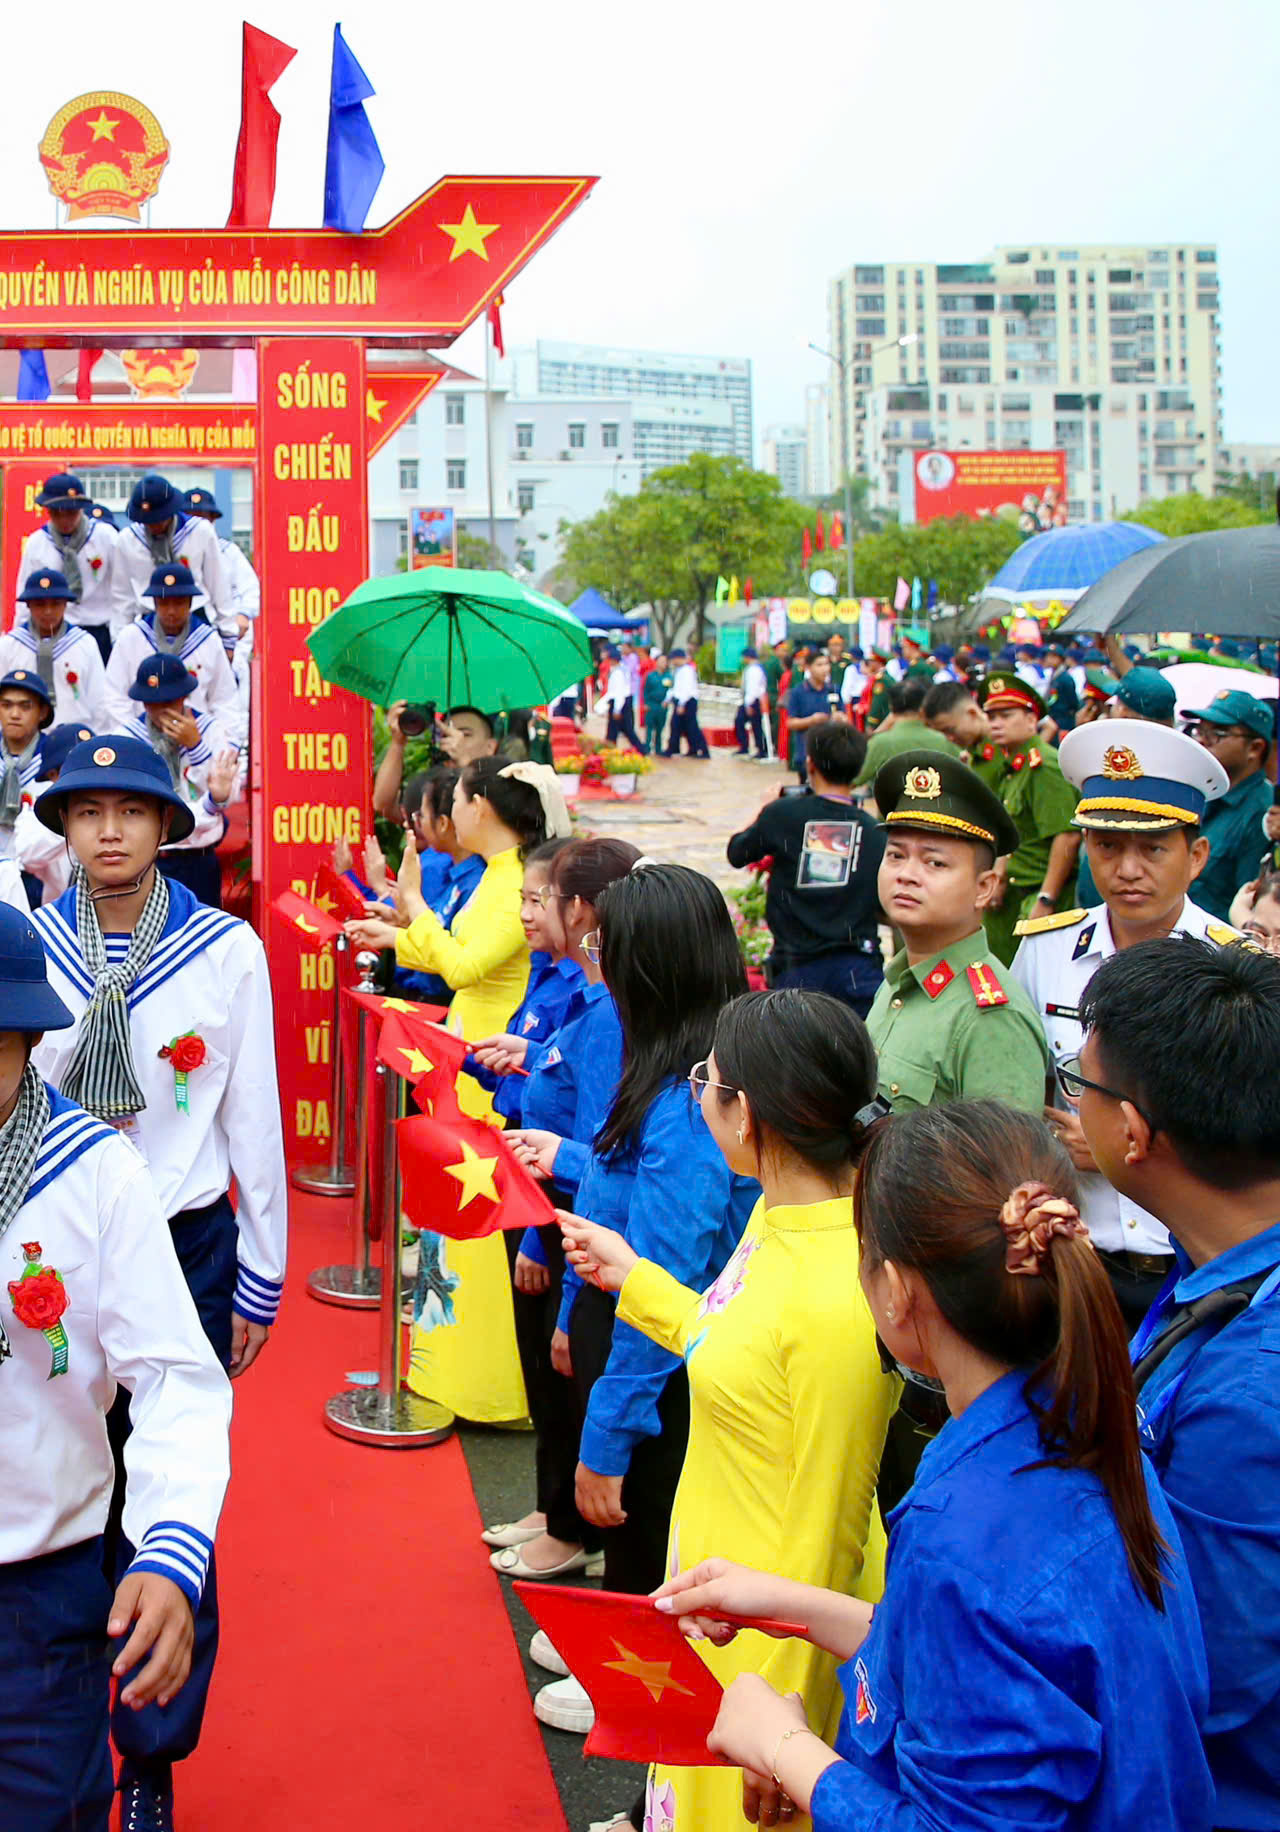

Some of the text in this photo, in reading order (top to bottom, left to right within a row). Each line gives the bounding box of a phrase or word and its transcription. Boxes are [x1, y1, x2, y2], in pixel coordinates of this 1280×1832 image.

[64, 264, 89, 306] VÀ
[94, 264, 155, 306] NGHĨA
[159, 270, 184, 313] VỤ
[189, 258, 228, 305] CỦA
[233, 257, 271, 305] MỖI
[276, 262, 330, 305] CÔNG
[335, 262, 376, 305] DÂN
[277, 359, 348, 409] SỐNG
[12, 423, 26, 452] VỆ
[29, 419, 43, 448] TỔ
[44, 420, 76, 450] QUỐC
[78, 422, 93, 448] LÀ
[94, 421, 132, 450] QUYỀN
[134, 422, 150, 448] VÀ
[151, 423, 187, 448] NGHĨA
[189, 426, 205, 453] VỤ
[207, 420, 230, 448] CỦA
[274, 432, 352, 480] CHIẾN
[288, 503, 340, 552] ĐẤU
[284, 733, 349, 770] THEO
[273, 806, 360, 844] GƯƠNG
[300, 941, 334, 990] HỒ
[305, 1020, 331, 1064] VĨ
